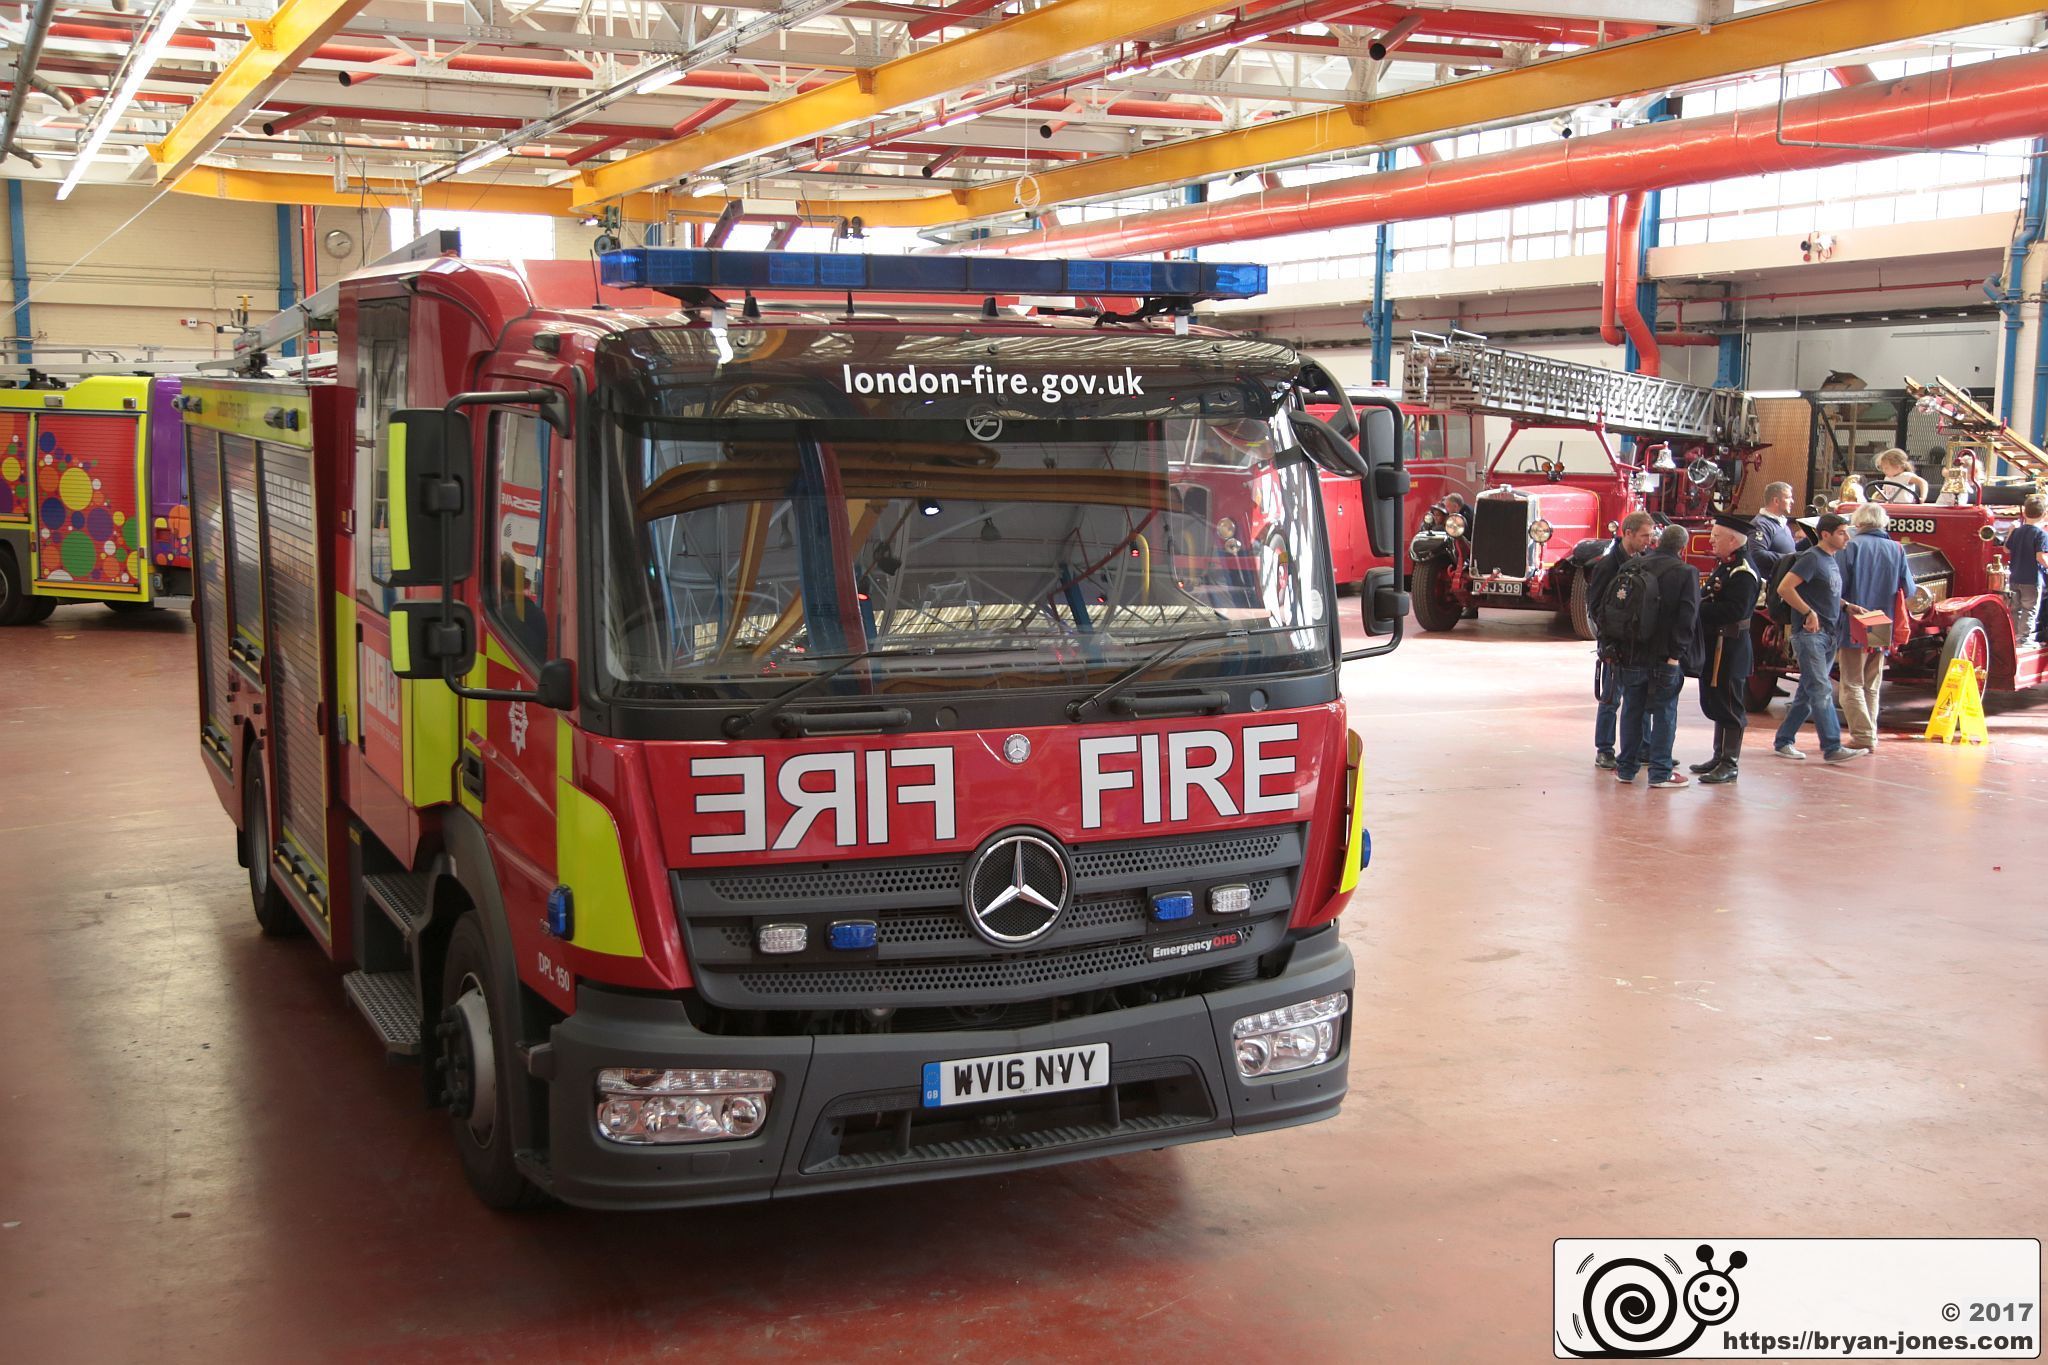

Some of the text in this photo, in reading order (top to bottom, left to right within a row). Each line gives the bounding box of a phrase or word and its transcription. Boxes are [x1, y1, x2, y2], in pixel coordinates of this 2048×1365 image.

[843, 364, 1144, 403] london-fire.gov.uk
[1498, 583, 1520, 593] 309
[1079, 723, 1300, 830] FIRE
[538, 951, 570, 992] DPL 150
[953, 1050, 1096, 1097] WV16 NVY
[926, 1090, 939, 1100] GB
